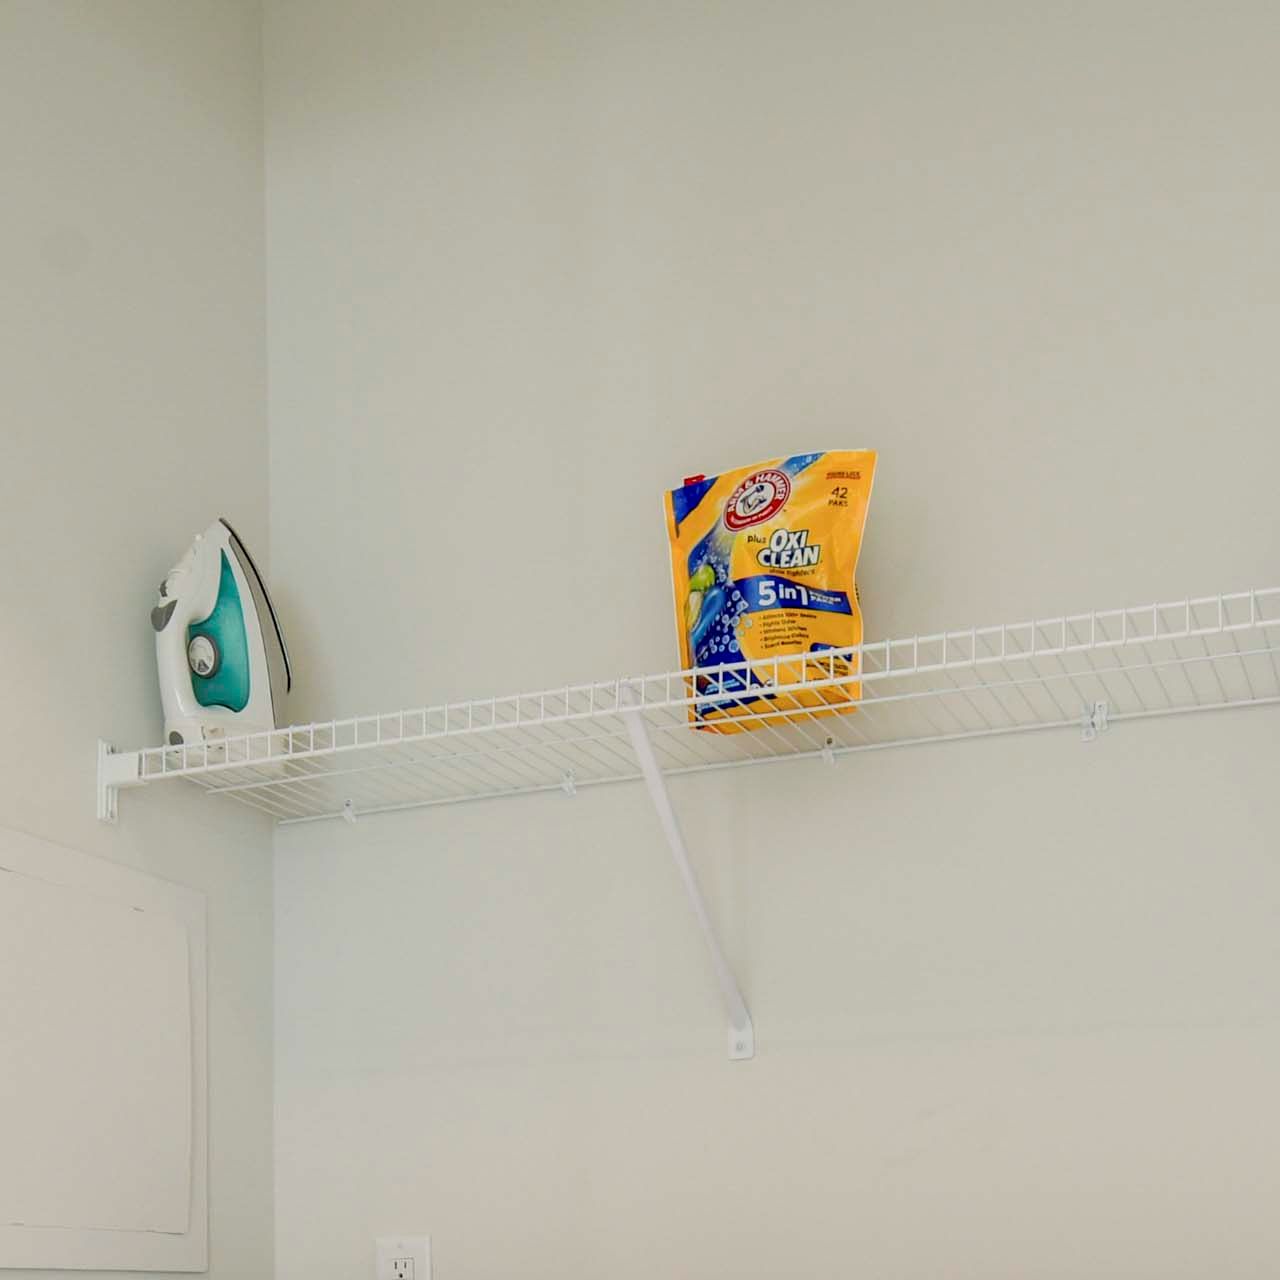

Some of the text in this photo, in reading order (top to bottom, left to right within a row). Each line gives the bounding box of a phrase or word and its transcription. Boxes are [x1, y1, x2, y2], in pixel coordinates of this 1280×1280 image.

[832, 487, 848, 499] 42
[748, 534, 767, 544] plus
[770, 528, 809, 553] OXI
[757, 545, 821, 569] CLEAN
[758, 580, 777, 606] 5
[778, 583, 797, 601] in
[795, 585, 810, 606] 1
